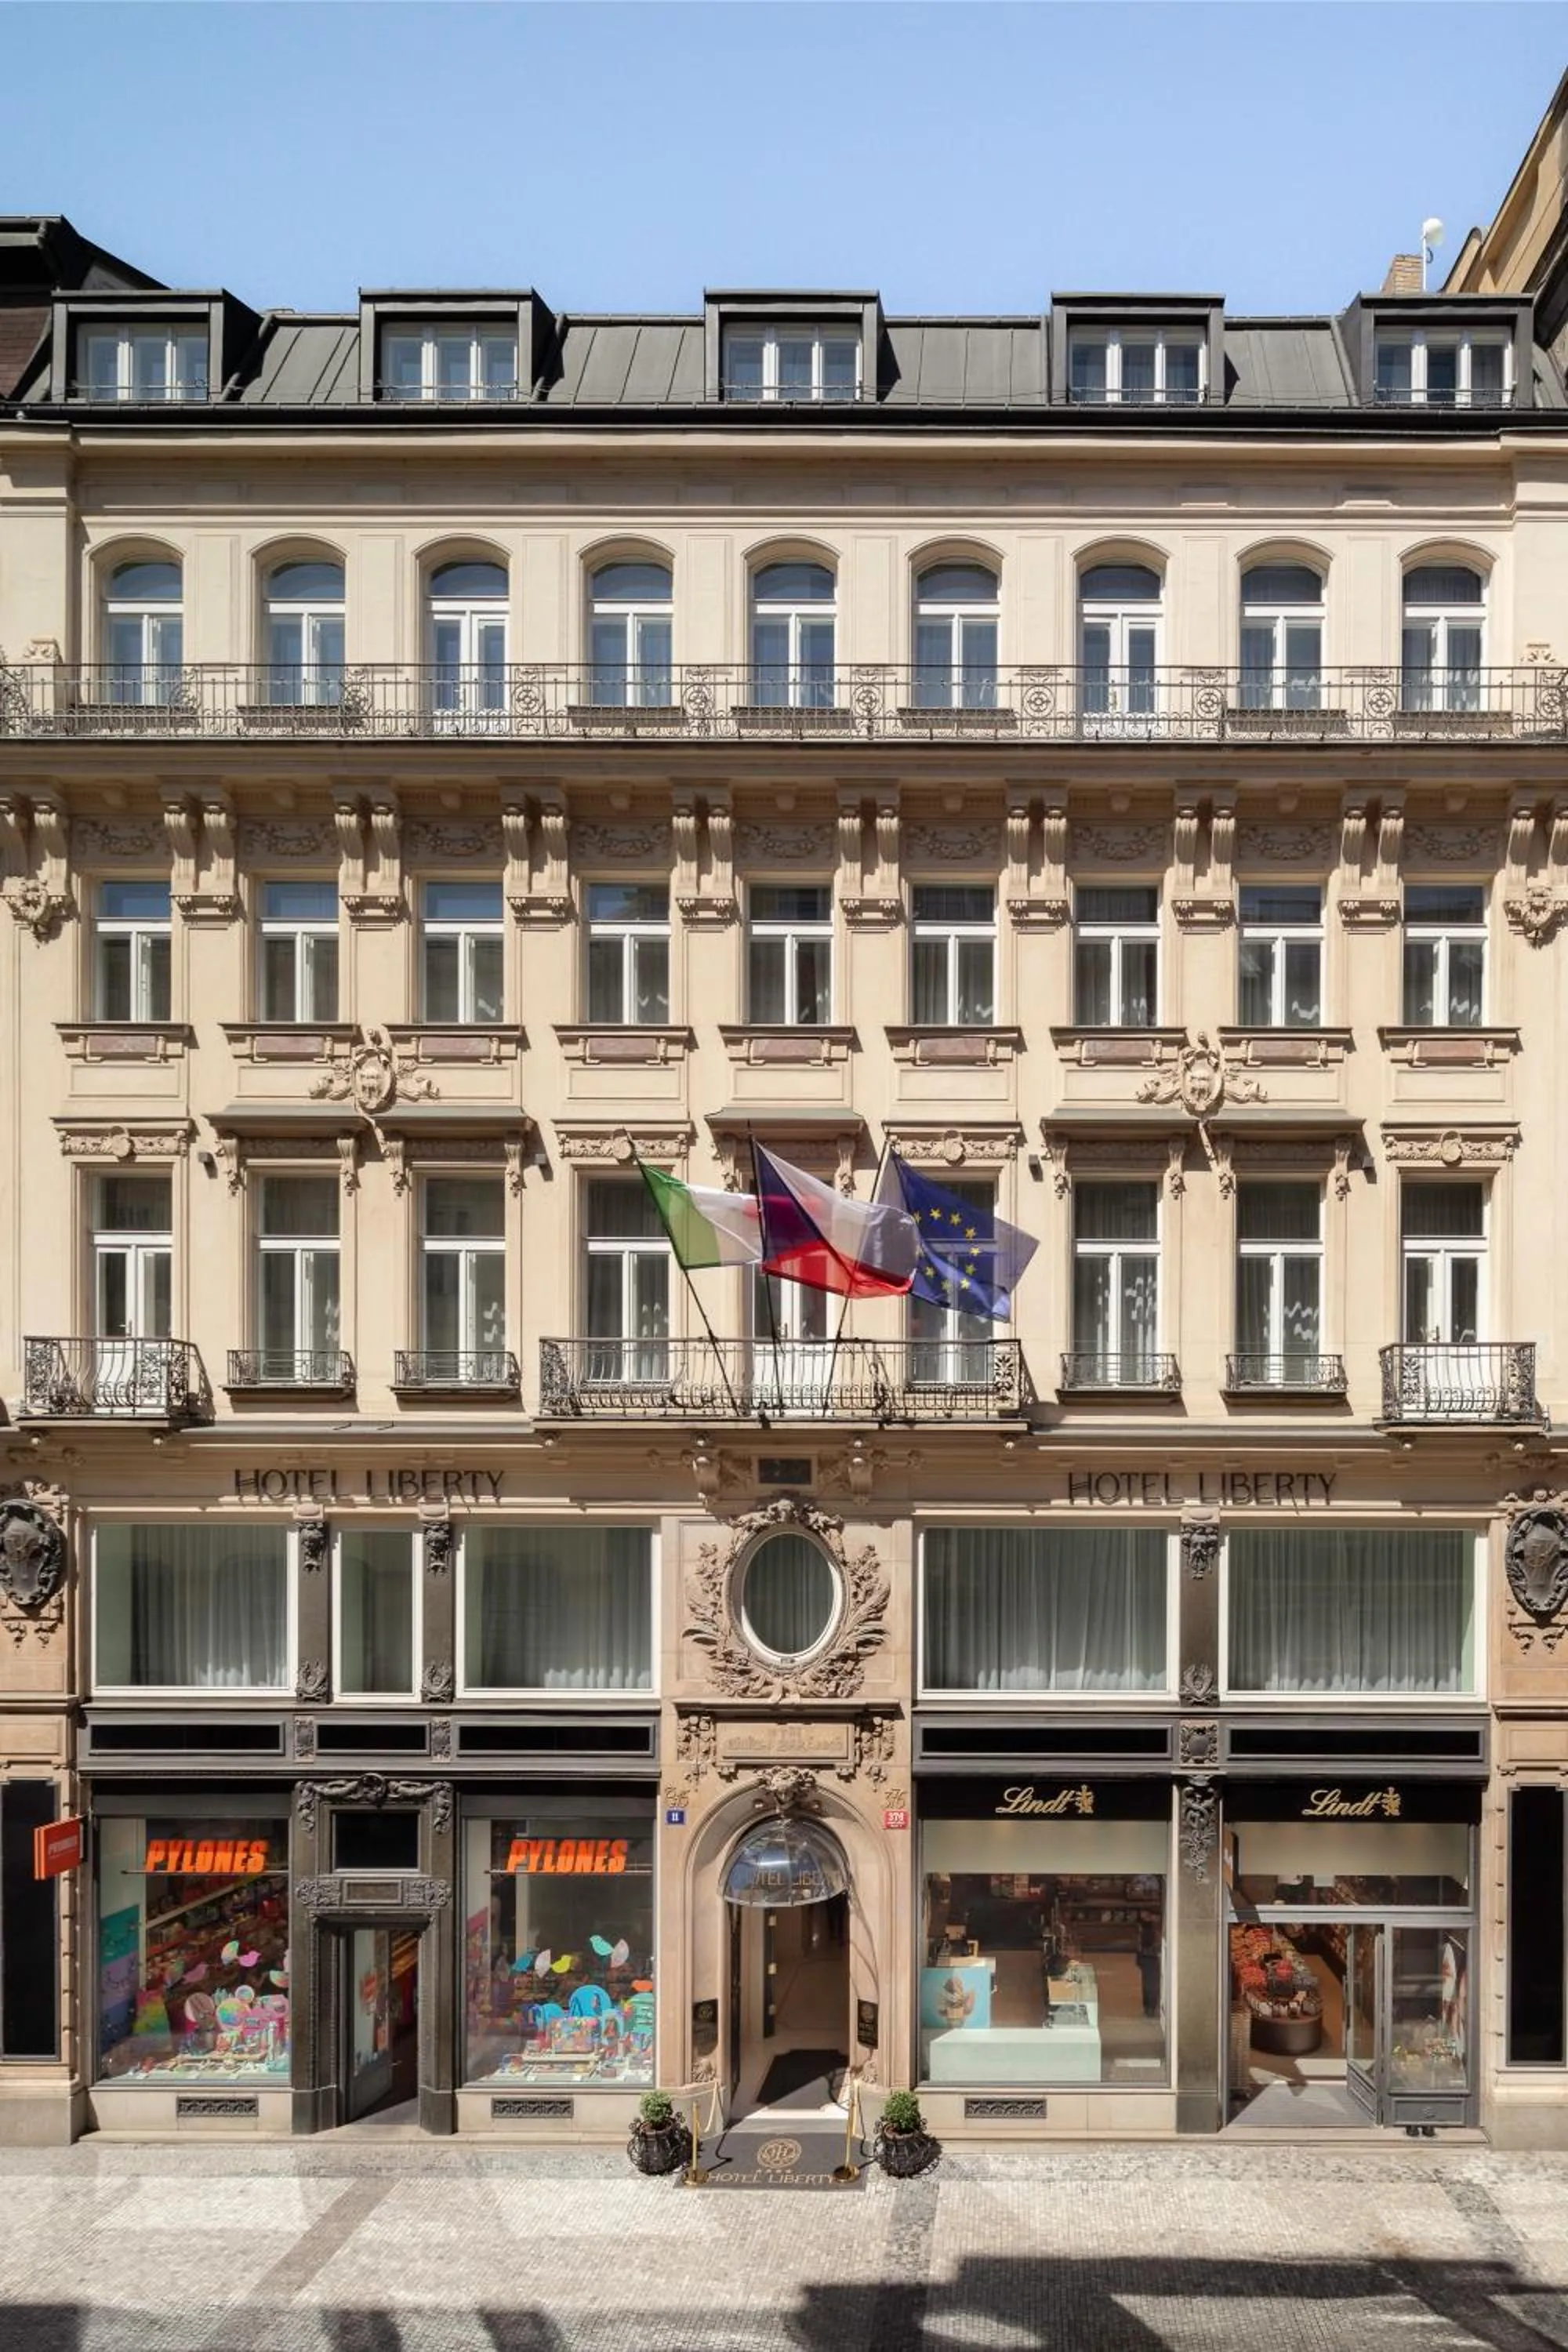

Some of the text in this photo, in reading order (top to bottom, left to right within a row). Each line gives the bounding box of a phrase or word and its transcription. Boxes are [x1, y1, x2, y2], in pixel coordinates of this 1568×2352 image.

[235, 1469, 504, 1504] HOTEL LIBERTY
[1068, 1472, 1336, 1506] HOTEL LIBERTY
[995, 1787, 1076, 1813] Lindt
[1301, 1788, 1382, 1816] Lindt
[144, 1838, 269, 1874] PYLONES
[506, 1838, 628, 1874] PYLONES
[706, 2171, 834, 2186] HOTEL LIBERTY
